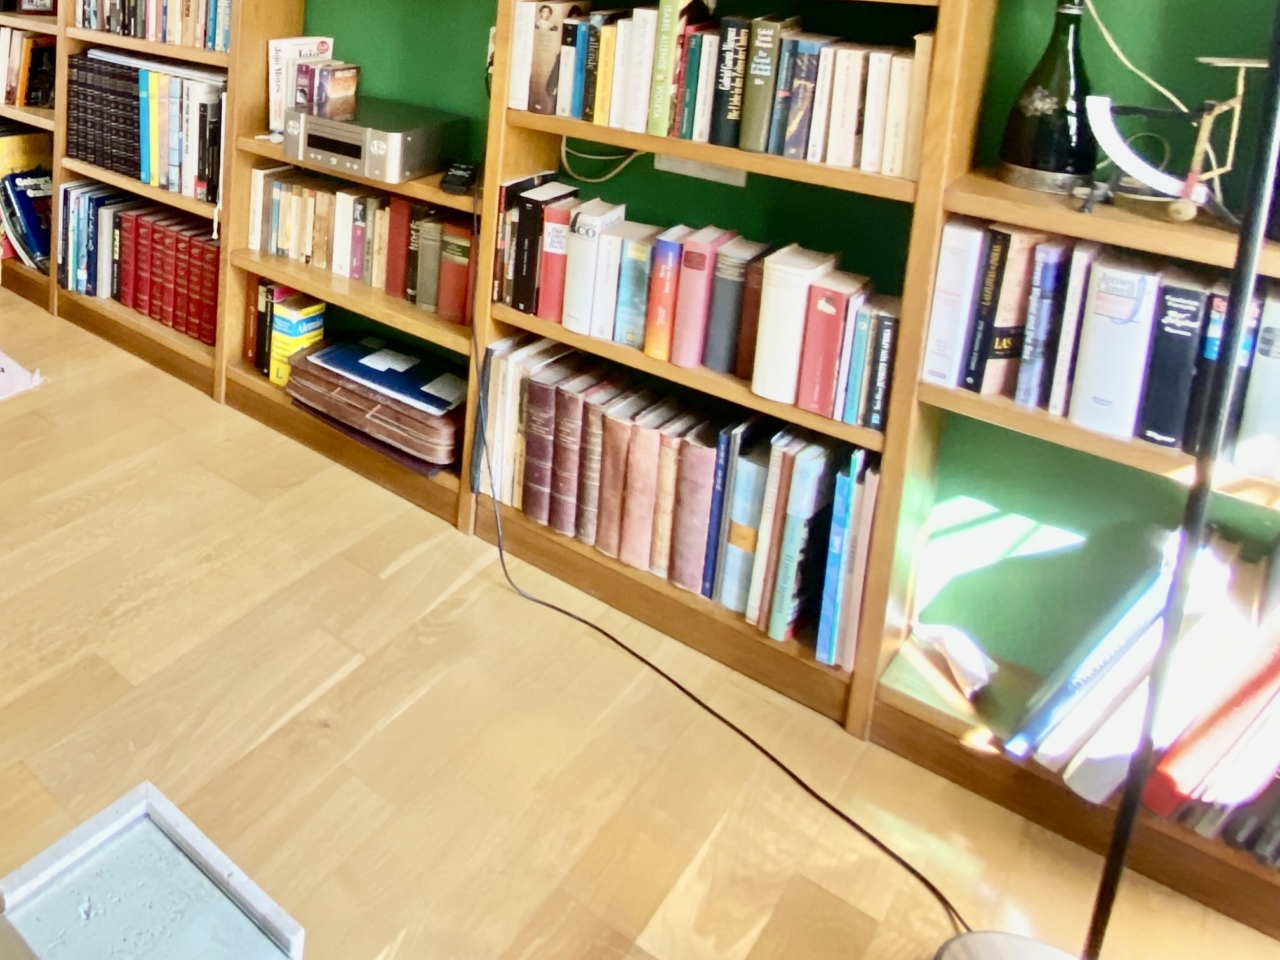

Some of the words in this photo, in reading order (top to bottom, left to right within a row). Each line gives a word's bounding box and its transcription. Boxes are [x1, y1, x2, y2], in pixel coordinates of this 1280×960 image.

[661, 5, 673, 32] ISABEL
[587, 36, 599, 70] allende
[657, 34, 669, 71] ALLENDE
[653, 86, 664, 119] VIOLETA
[276, 367, 283, 380] L
